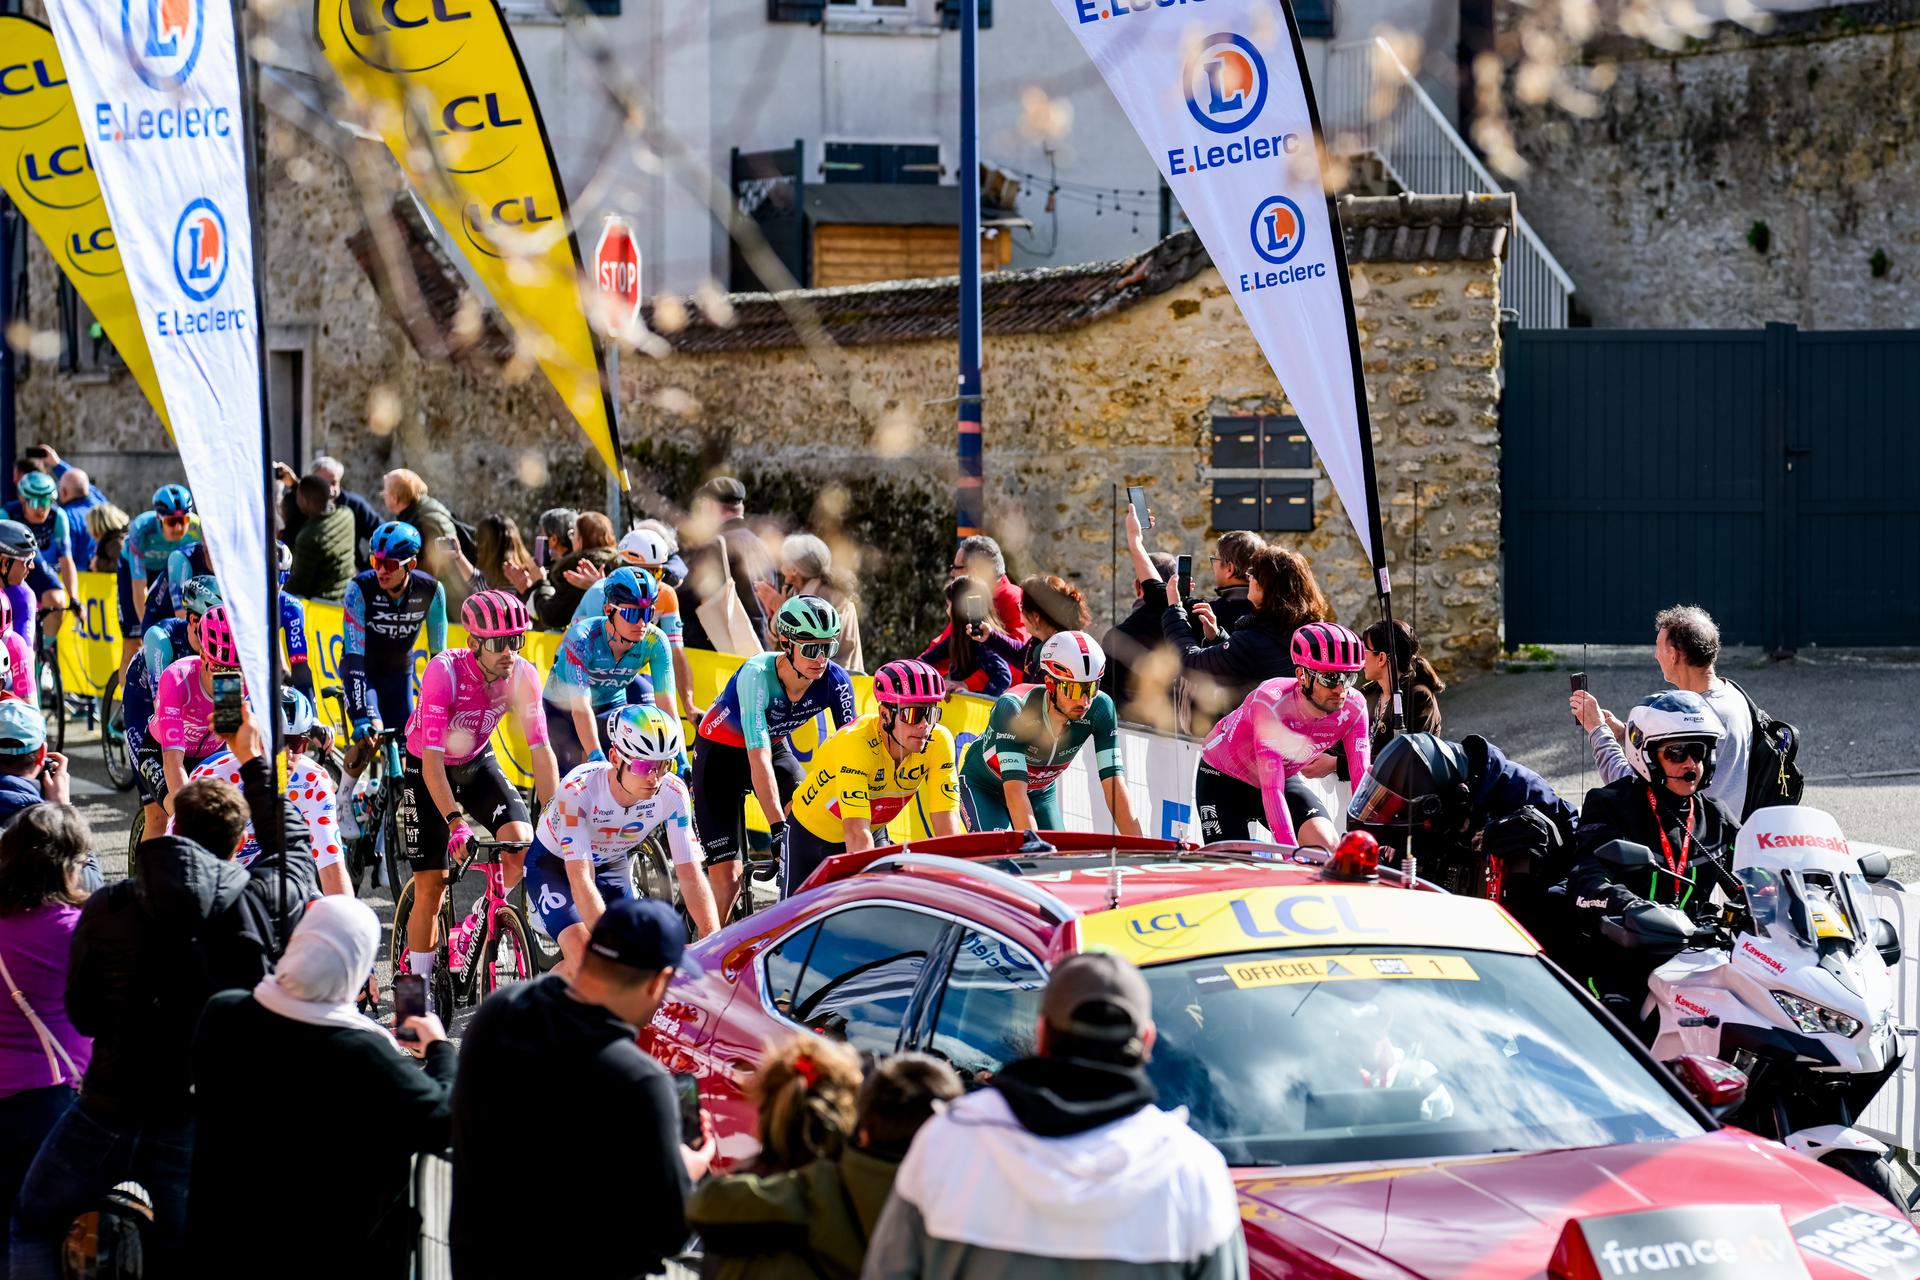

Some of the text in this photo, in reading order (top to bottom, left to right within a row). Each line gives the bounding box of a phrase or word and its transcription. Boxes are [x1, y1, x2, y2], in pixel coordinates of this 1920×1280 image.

[0, 59, 68, 95] CL
[95, 103, 231, 141] E.Leclerc
[1168, 132, 1299, 175] E.Leclerc
[468, 196, 553, 233] LCL
[72, 228, 115, 254] LC
[601, 260, 637, 291] STOP
[1240, 262, 1326, 292] E.Leclerc
[157, 308, 246, 336] E.Leclerc
[289, 618, 302, 648] BOSS
[367, 621, 420, 636] ASTAN
[316, 630, 344, 680] LC
[801, 769, 836, 806] LCL LCL
[843, 791, 869, 801] LCL
[944, 783, 960, 792] LC
[1756, 832, 1850, 855] Kawasaki
[1131, 912, 1200, 935] LCL
[1229, 895, 1389, 938] LCL
[459, 908, 486, 983] cannondale
[1742, 941, 1788, 974] Kawasaki
[1237, 960, 1325, 982] OFFICIEL
[1429, 959, 1444, 975] 1
[1674, 993, 1710, 1017] Kawasaki
[1602, 1239, 1738, 1275] france
